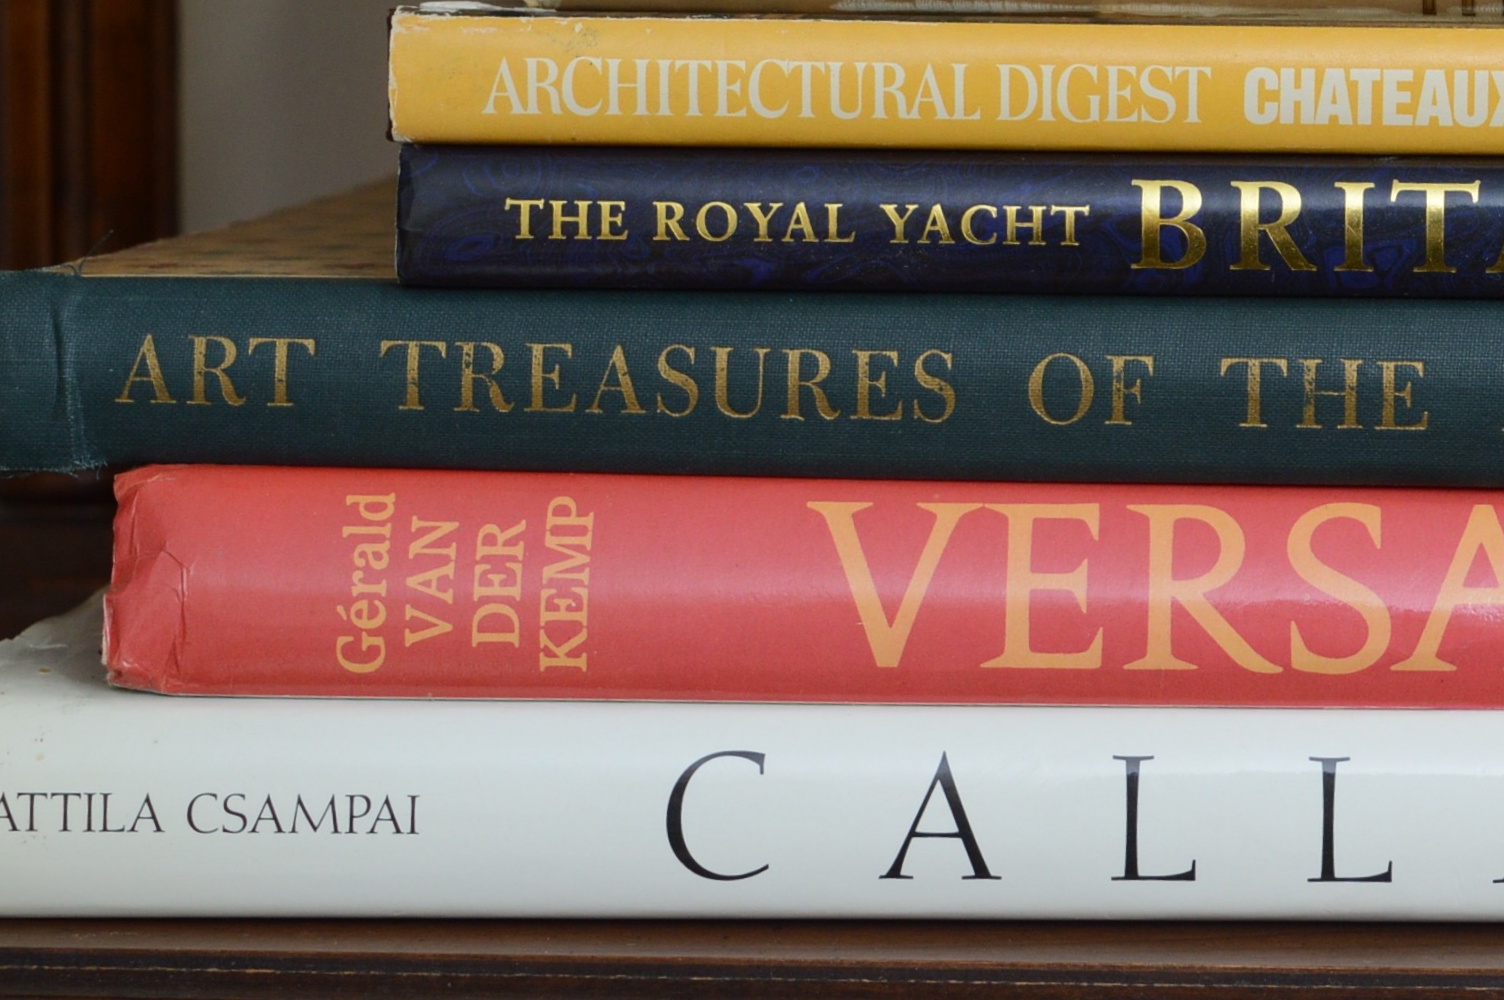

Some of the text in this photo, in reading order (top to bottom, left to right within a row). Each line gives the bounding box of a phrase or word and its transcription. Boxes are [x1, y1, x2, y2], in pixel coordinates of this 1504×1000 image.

[482, 56, 981, 121] ARCHITECTURAL
[996, 64, 1212, 124] DIGEST
[504, 196, 629, 242] THE
[652, 200, 857, 245] ROYAL
[879, 202, 1091, 248] YACHT
[115, 333, 316, 407] ART
[379, 339, 958, 423] TREASURES
[1027, 352, 1156, 427] OF
[1220, 356, 1431, 433] THE
[335, 491, 397, 675] Gérald
[405, 515, 460, 648] VAN
[472, 518, 527, 648] DER
[539, 494, 595, 673] KEMP
[186, 792, 421, 835] CSAMPAI
